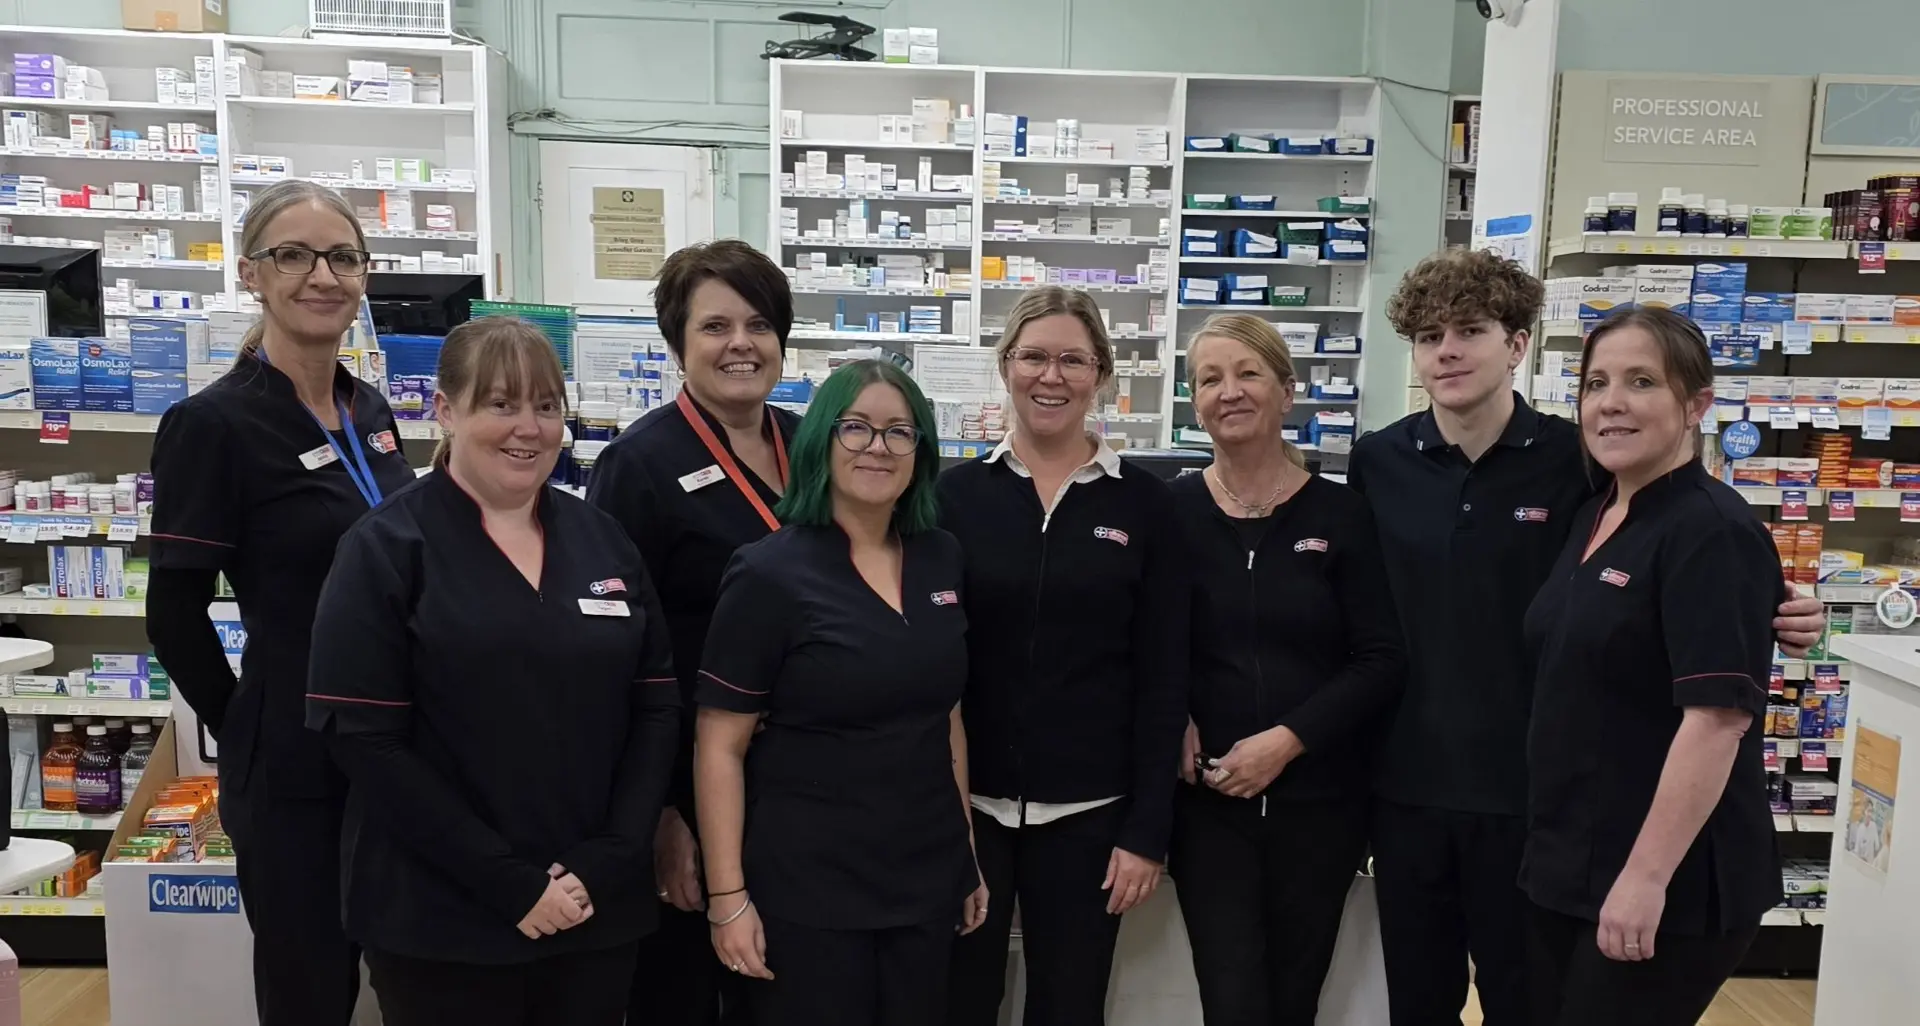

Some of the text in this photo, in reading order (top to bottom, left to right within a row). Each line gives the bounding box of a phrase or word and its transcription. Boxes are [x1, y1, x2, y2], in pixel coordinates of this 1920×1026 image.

[1612, 98, 1763, 118] PROFESSIONAL
[1613, 126, 1757, 147] SERVICE AREA
[1583, 284, 1610, 293] Codral
[1639, 285, 1666, 293] Codral
[32, 358, 79, 368] OsmoLax
[82, 358, 131, 369] OsmoLax
[108, 368, 129, 376] Relief
[1726, 431, 1756, 446] health
[56, 556, 67, 594] microlax
[94, 556, 104, 595] microlax
[215, 624, 249, 649] Clea
[1787, 881, 1800, 891] flo
[151, 879, 237, 911] Clearwipe
